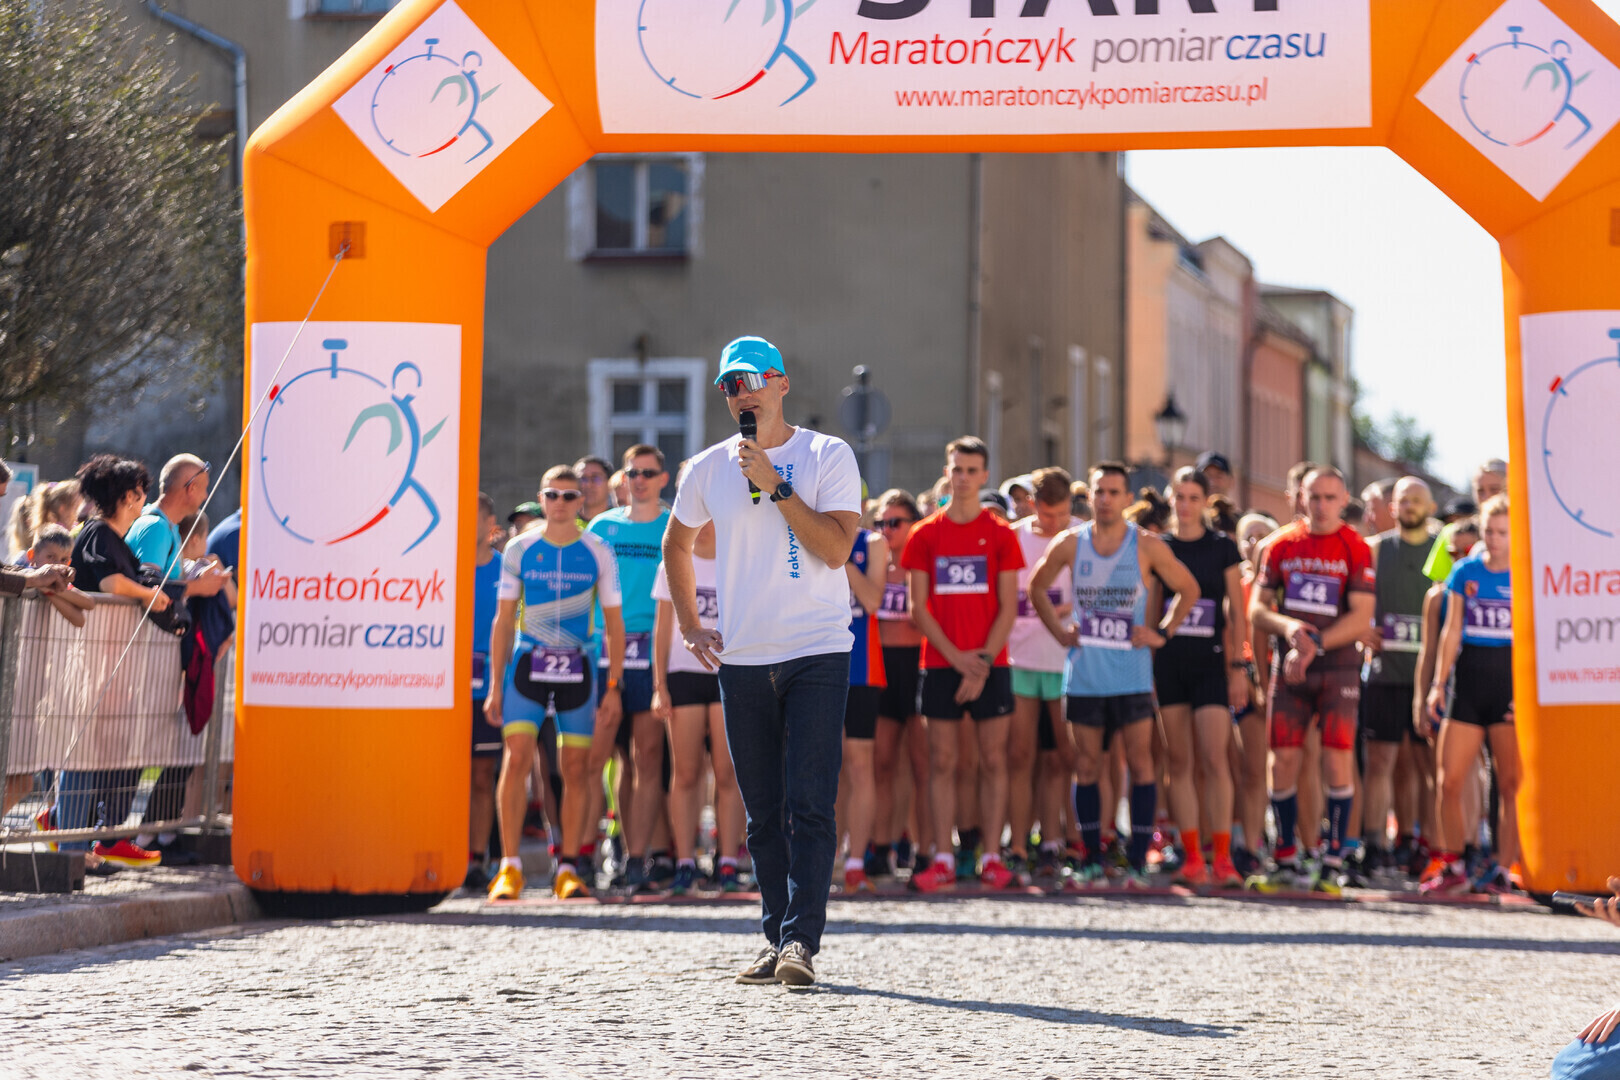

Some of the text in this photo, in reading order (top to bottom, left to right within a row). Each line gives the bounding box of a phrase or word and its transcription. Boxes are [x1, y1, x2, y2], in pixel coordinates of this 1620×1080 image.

[828, 28, 1077, 72] Maratończyk
[894, 76, 1269, 110] www.maratonczykpomiarczasu.pl
[947, 564, 977, 585] 96
[252, 567, 446, 611] Maratończyk
[1299, 581, 1328, 604] 44
[1088, 616, 1129, 641] 108
[1471, 605, 1512, 629] 119
[543, 655, 572, 674] 22
[251, 669, 447, 691] www.maratonczykpomiarczasu.pl
